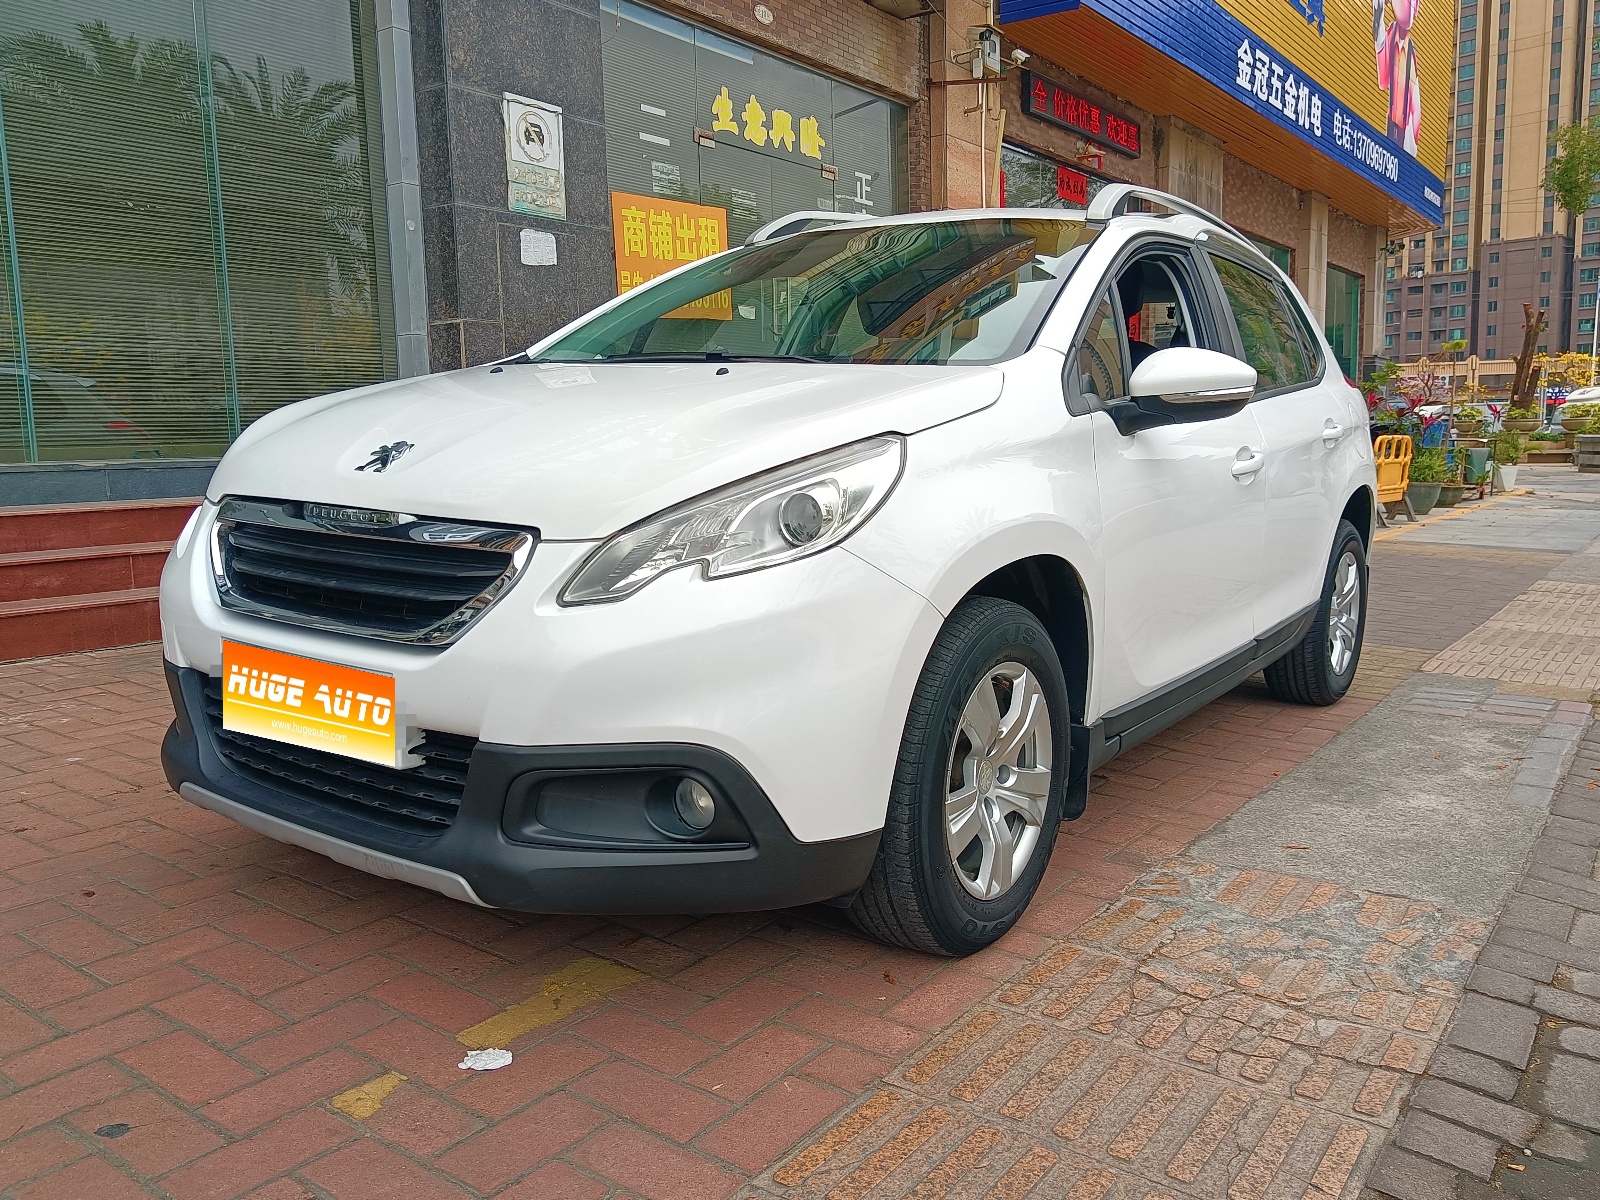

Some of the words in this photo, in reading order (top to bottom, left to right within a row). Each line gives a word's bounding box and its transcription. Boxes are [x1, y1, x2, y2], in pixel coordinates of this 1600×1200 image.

[1053, 86, 1101, 134] 价格优惠
[1236, 38, 1322, 137] 金冠五金机电
[621, 205, 720, 261] 商铺出租
[312, 505, 379, 524] PEUGEOT
